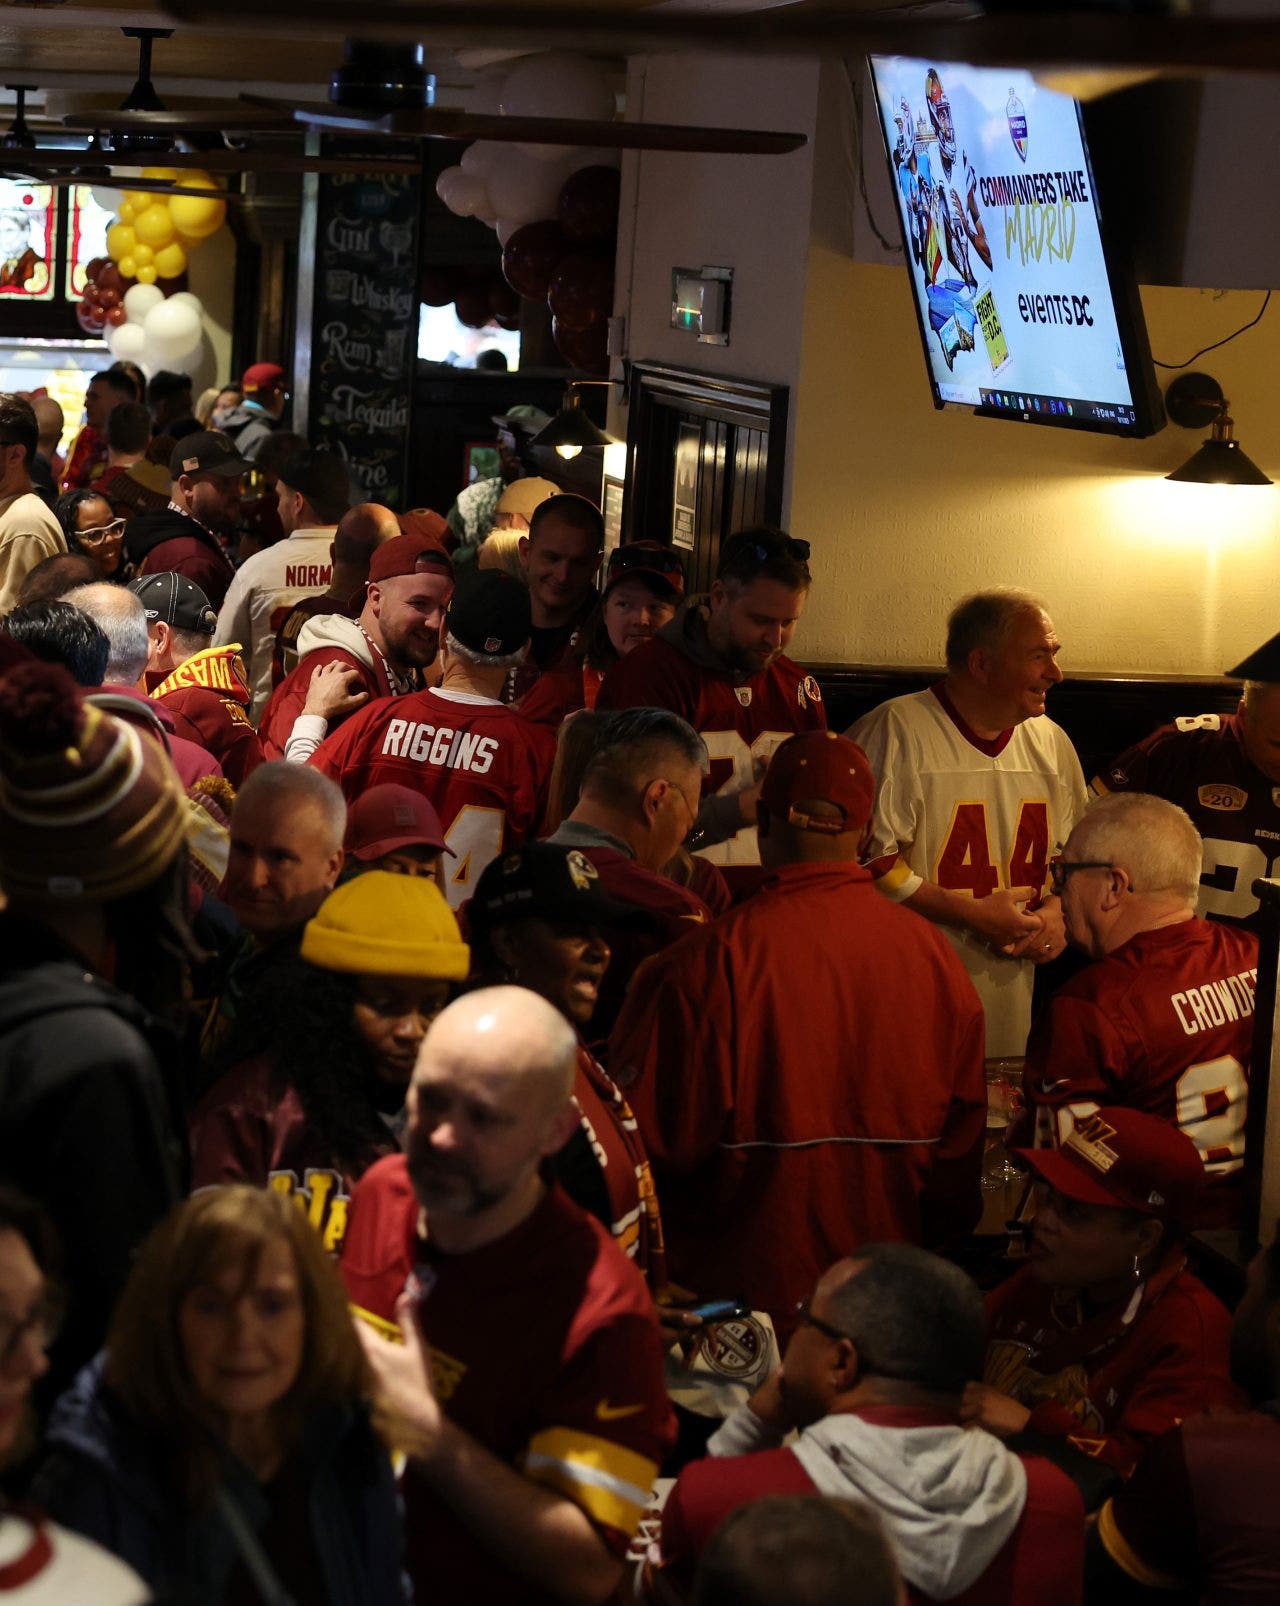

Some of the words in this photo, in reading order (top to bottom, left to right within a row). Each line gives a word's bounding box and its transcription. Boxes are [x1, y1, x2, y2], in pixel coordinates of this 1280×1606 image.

[979, 173, 1057, 207] COMMANDERS
[1054, 170, 1089, 202] TAKE
[1003, 194, 1075, 267] MADRID
[286, 564, 332, 587] NORM
[381, 717, 500, 774] RIGGINS
[933, 799, 1051, 912] 44
[1171, 967, 1258, 1035] CROWDE
[1176, 1054, 1251, 1177] 8
